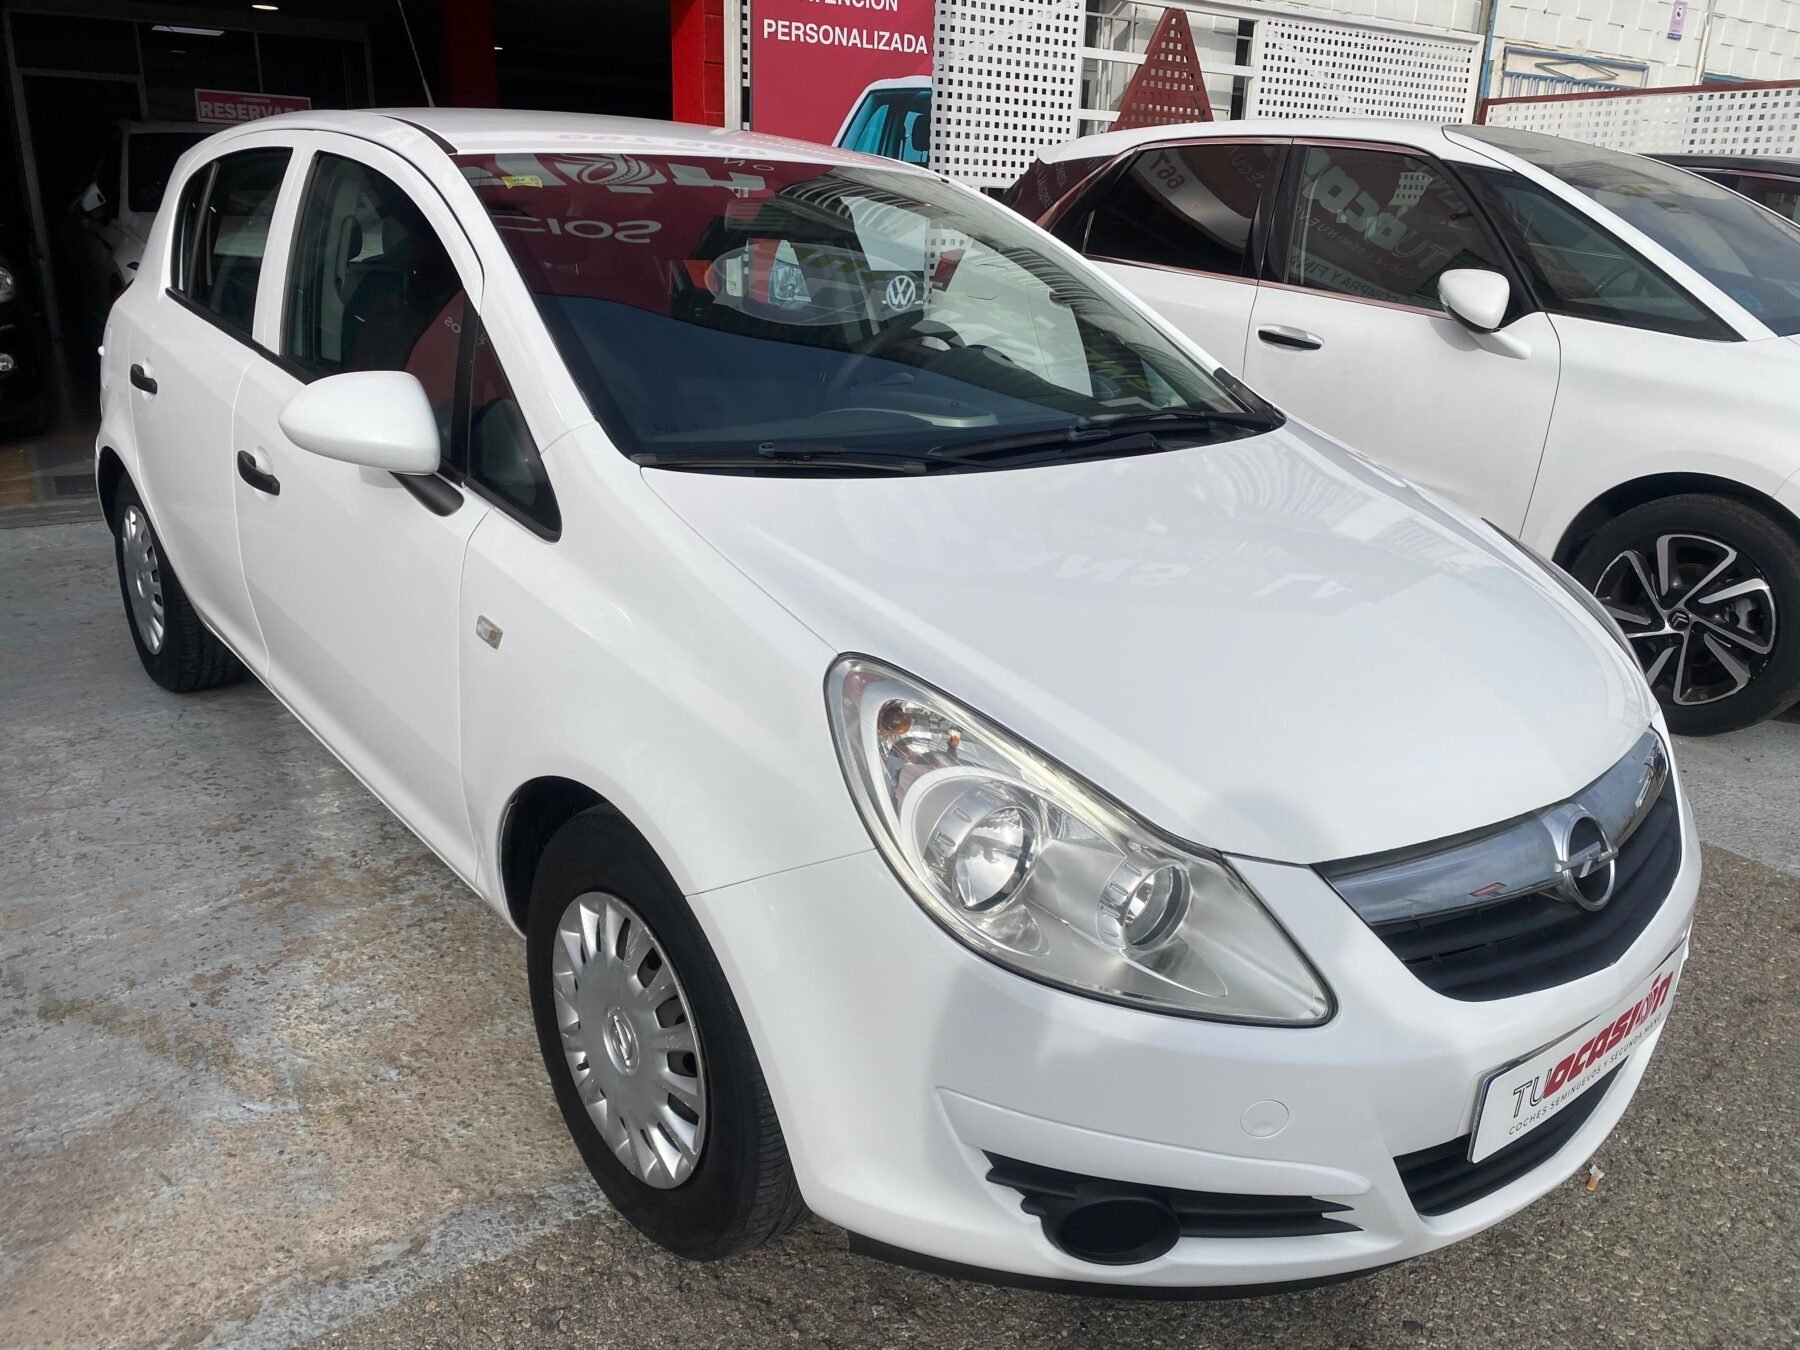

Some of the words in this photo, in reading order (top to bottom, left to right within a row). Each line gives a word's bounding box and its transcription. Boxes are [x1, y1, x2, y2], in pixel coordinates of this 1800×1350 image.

[763, 19, 928, 54] PERSONALIZADA
[200, 101, 308, 120] RESERVA
[1509, 1106, 1547, 1135] COCHES
[1550, 1065, 1601, 1110] SEMINUEVOS
